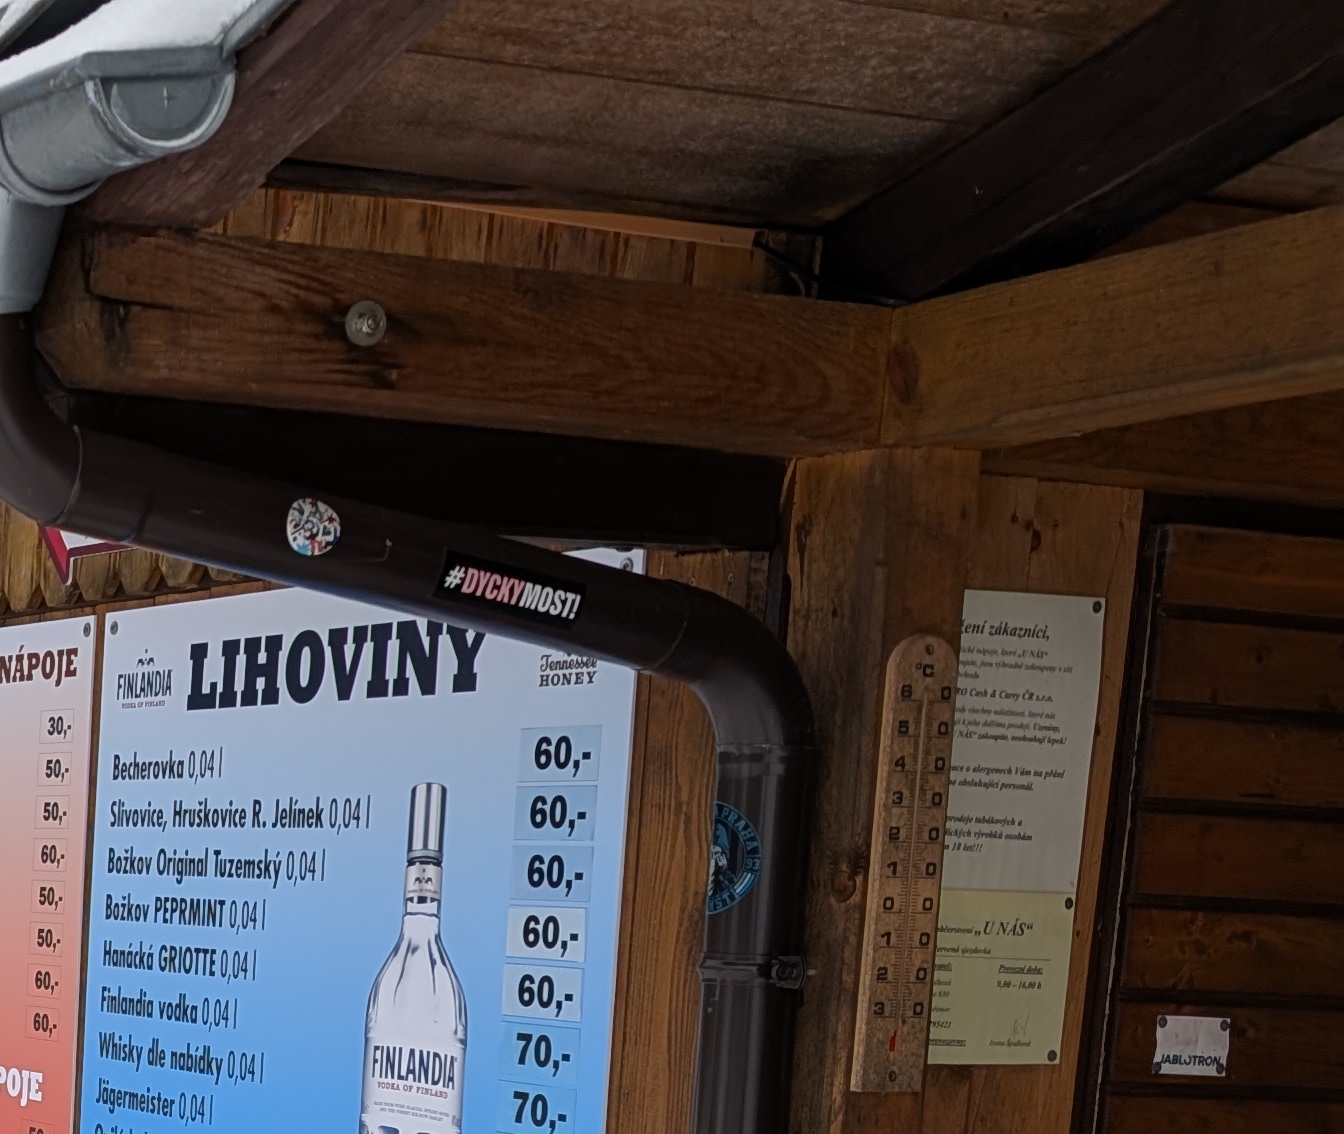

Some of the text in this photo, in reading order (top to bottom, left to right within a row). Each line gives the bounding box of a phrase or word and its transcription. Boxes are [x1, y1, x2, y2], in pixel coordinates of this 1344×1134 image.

[444, 565, 581, 620] #DYCKYMOST!
[186, 619, 486, 711] LIHOVINY
[539, 671, 597, 688] HONEY
[540, 654, 597, 672] Tennessee
[116, 669, 173, 701] FINLANDIA
[47, 715, 71, 740] 30,-
[112, 750, 184, 781] Becherovka
[188, 749, 215, 785] 0,04
[534, 735, 592, 778] 60,-
[110, 798, 168, 832] Slivovice,
[172, 797, 247, 829] Hruškovice
[251, 799, 267, 829] R.
[271, 796, 324, 829] Jelínek
[328, 798, 361, 835] 0,04
[530, 795, 587, 837] 60,-
[40, 845, 65, 869] 60,-
[107, 846, 152, 876] Božkov
[156, 847, 209, 885] Original
[213, 848, 282, 889] Tuzemský
[286, 851, 318, 887] 0,04
[527, 854, 584, 898] 60,-
[38, 887, 63, 911] 50,-
[522, 914, 579, 958] 60,-
[103, 940, 154, 971] Hanácká
[158, 944, 217, 977] GRIOTTE
[220, 949, 249, 985] 0,04
[518, 974, 574, 1018] 60,-
[372, 1045, 455, 1090] FINLANDIA
[516, 1032, 571, 1077] 70,-
[96, 1078, 175, 1114] Jägermeister
[178, 1092, 206, 1126] 0,04
